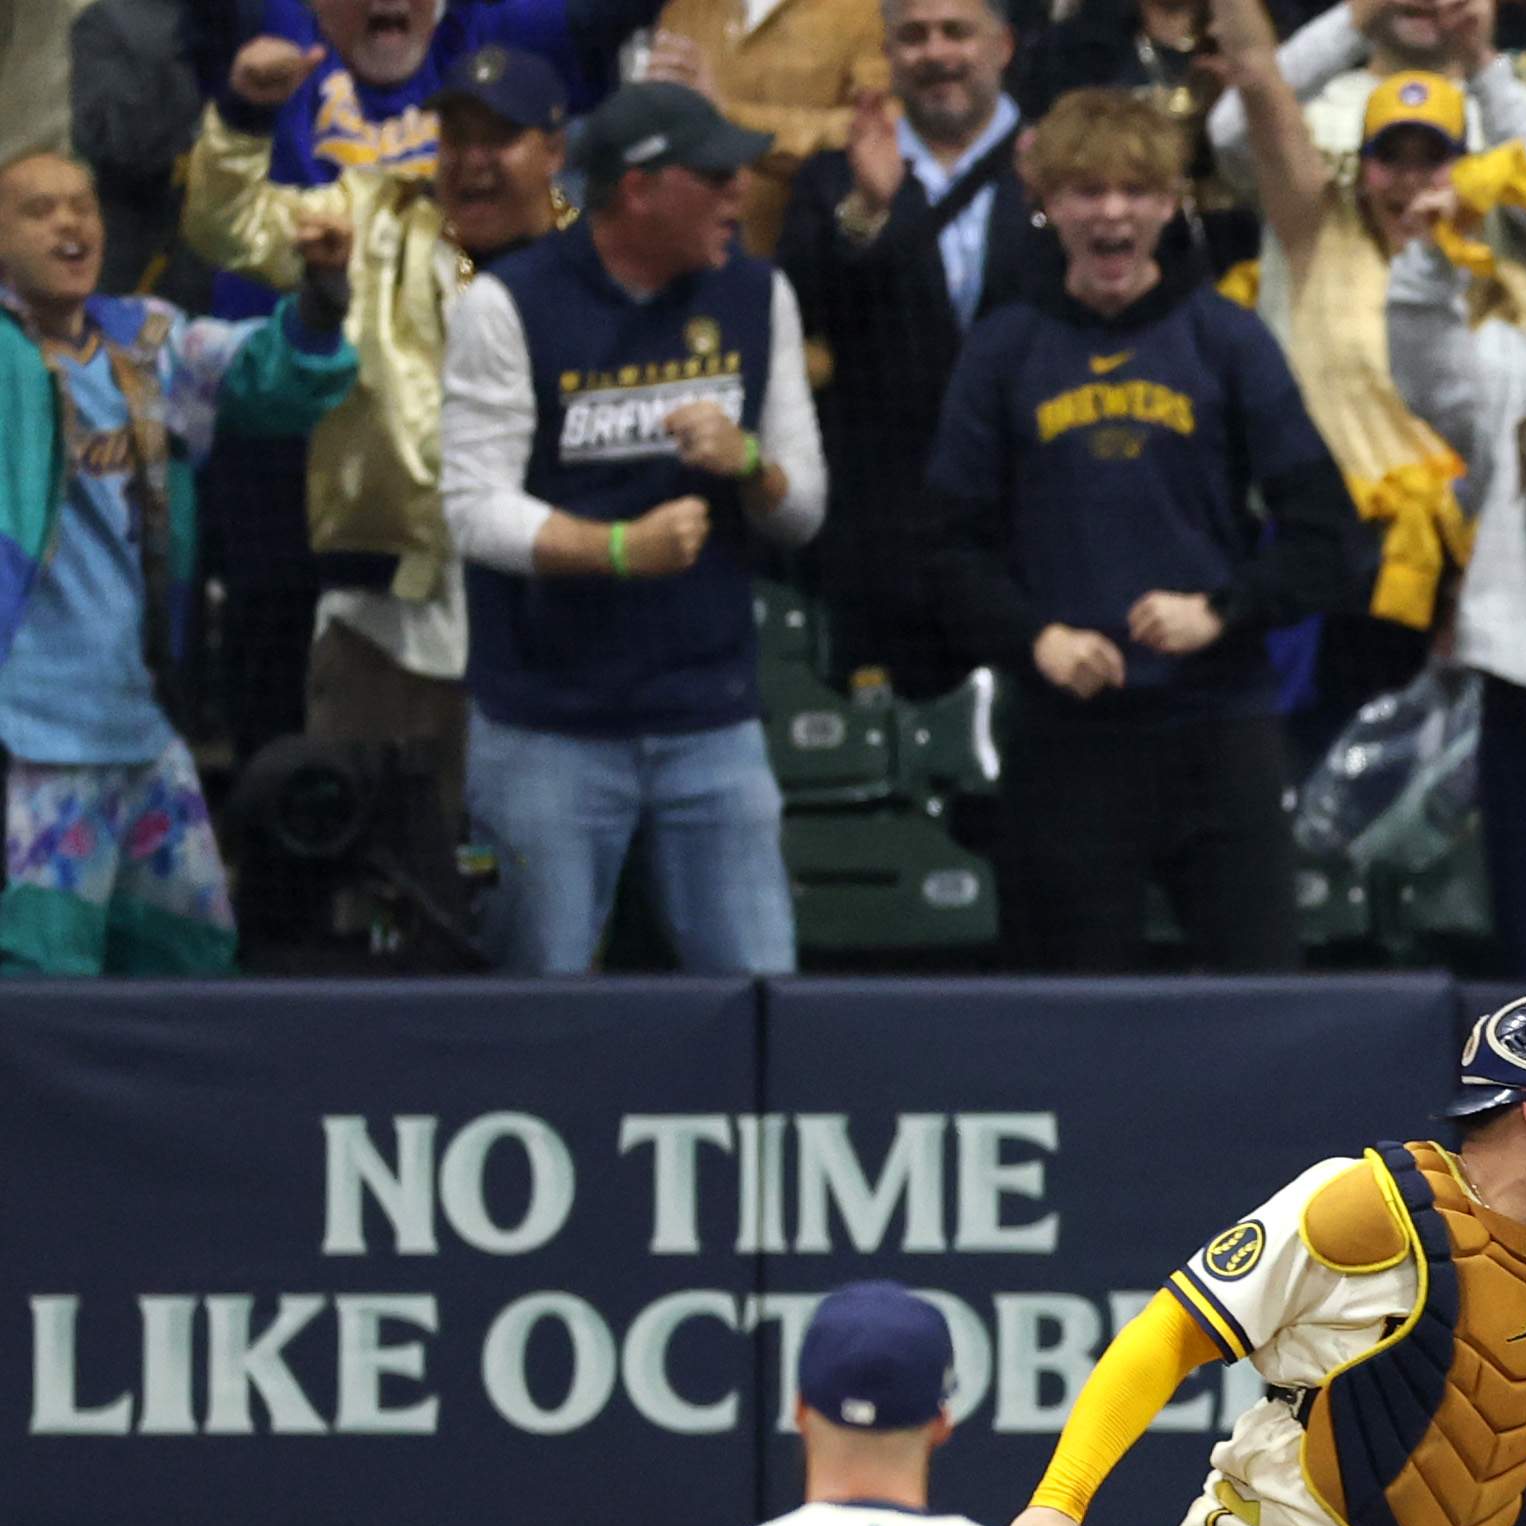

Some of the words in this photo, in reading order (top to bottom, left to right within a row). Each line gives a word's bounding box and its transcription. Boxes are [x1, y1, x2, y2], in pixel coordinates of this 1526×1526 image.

[1037, 379, 1195, 442] BREWERS
[322, 1110, 576, 1256] NO
[618, 1112, 1059, 1255] TIME
[28, 1293, 439, 1436] LIKE
